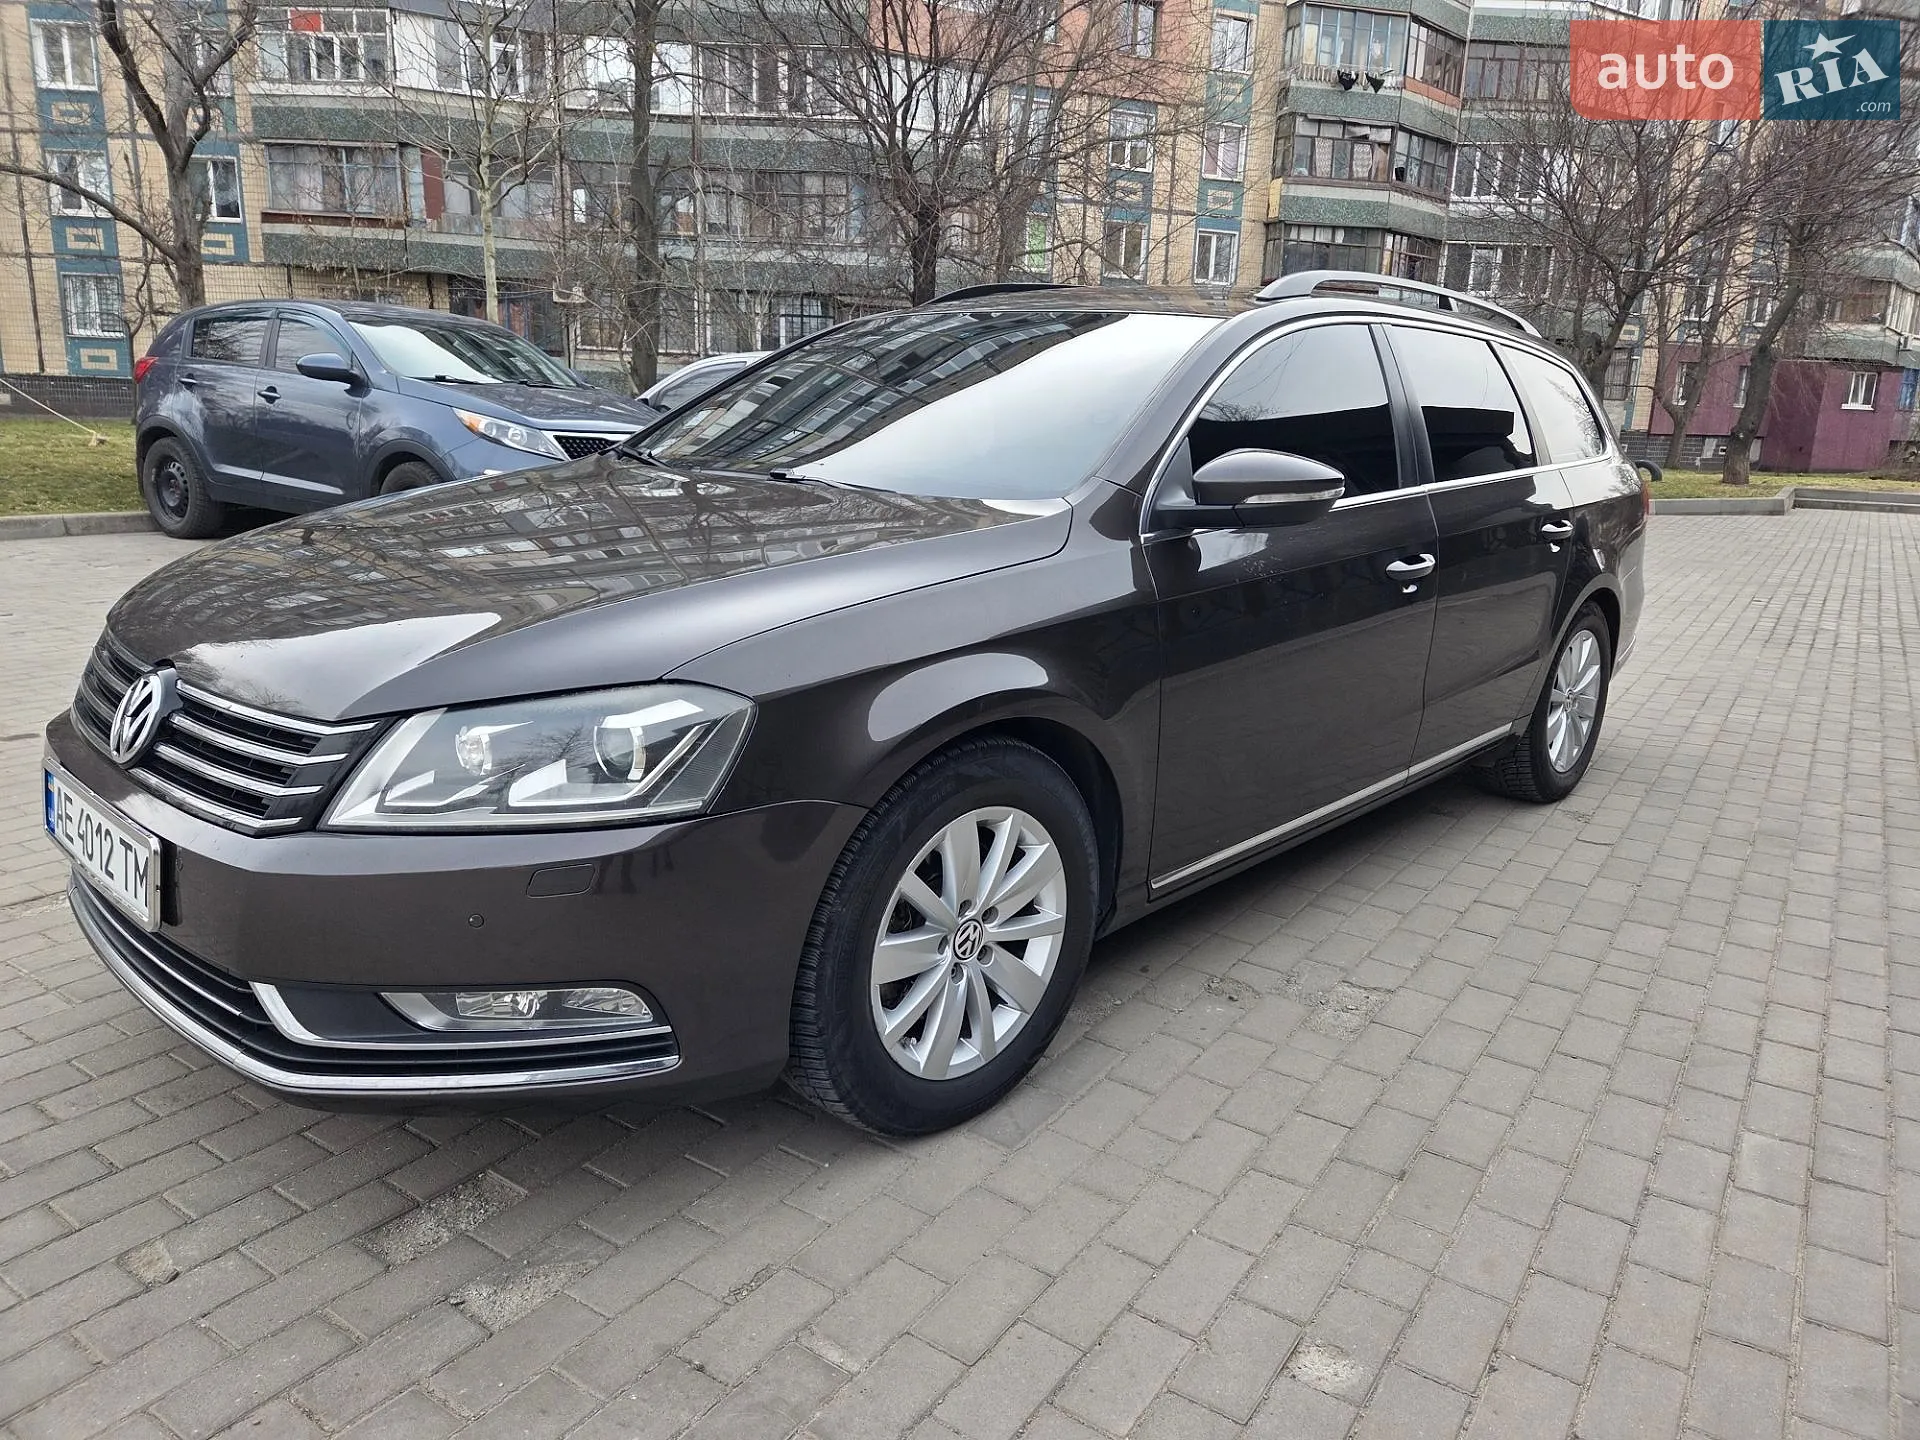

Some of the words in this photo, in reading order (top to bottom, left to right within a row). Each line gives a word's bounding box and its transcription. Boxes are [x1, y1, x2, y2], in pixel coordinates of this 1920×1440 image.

[56, 786, 74, 845] AE
[77, 808, 115, 880] 4012
[119, 836, 149, 908] TM
